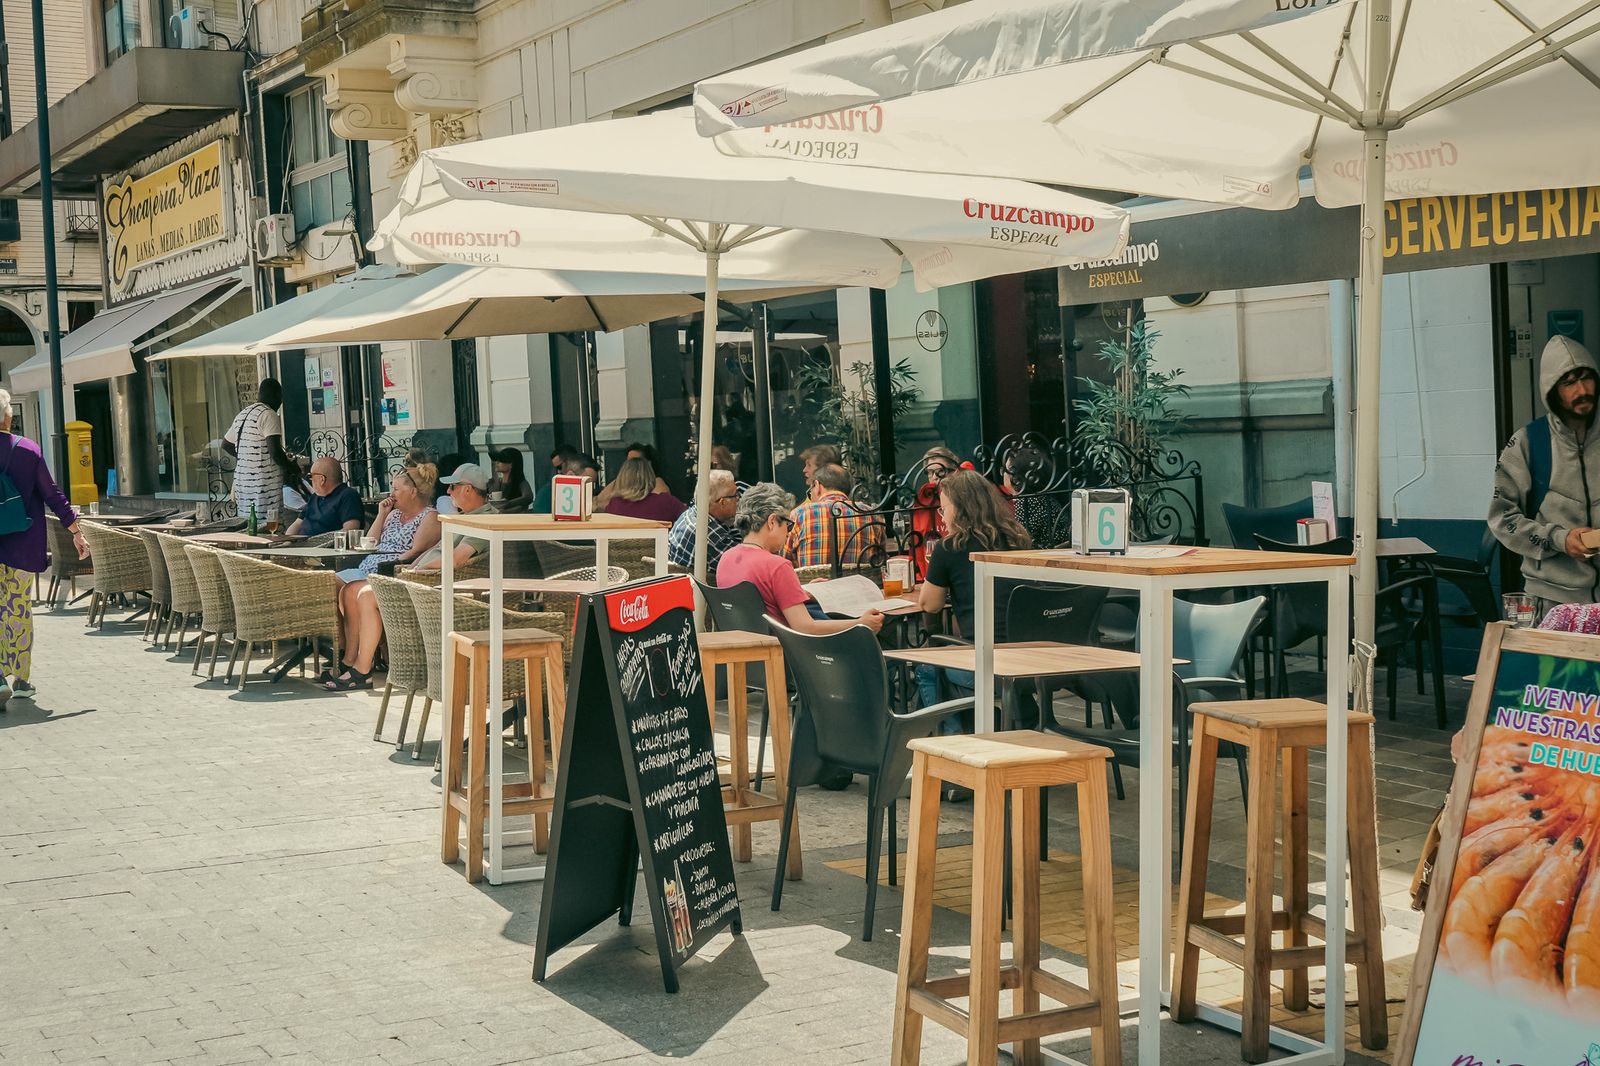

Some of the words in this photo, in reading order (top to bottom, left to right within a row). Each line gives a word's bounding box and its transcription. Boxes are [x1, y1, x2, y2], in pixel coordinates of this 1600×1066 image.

[178, 158, 220, 205] Plaza
[963, 197, 1095, 234] Cruzcampo
[136, 239, 156, 263] LANAS
[160, 227, 185, 253] MEDIAS
[189, 213, 220, 243] LABORES
[990, 226, 1059, 248] ESPECIAL
[1088, 269, 1143, 288] ESPECIAL
[562, 486, 574, 513] 3
[1098, 506, 1115, 546] 6
[1580, 693, 1596, 715] Y
[1496, 708, 1600, 744] NUESTRAS
[641, 734, 662, 751] CALLOS
[1530, 742, 1560, 768] DE
